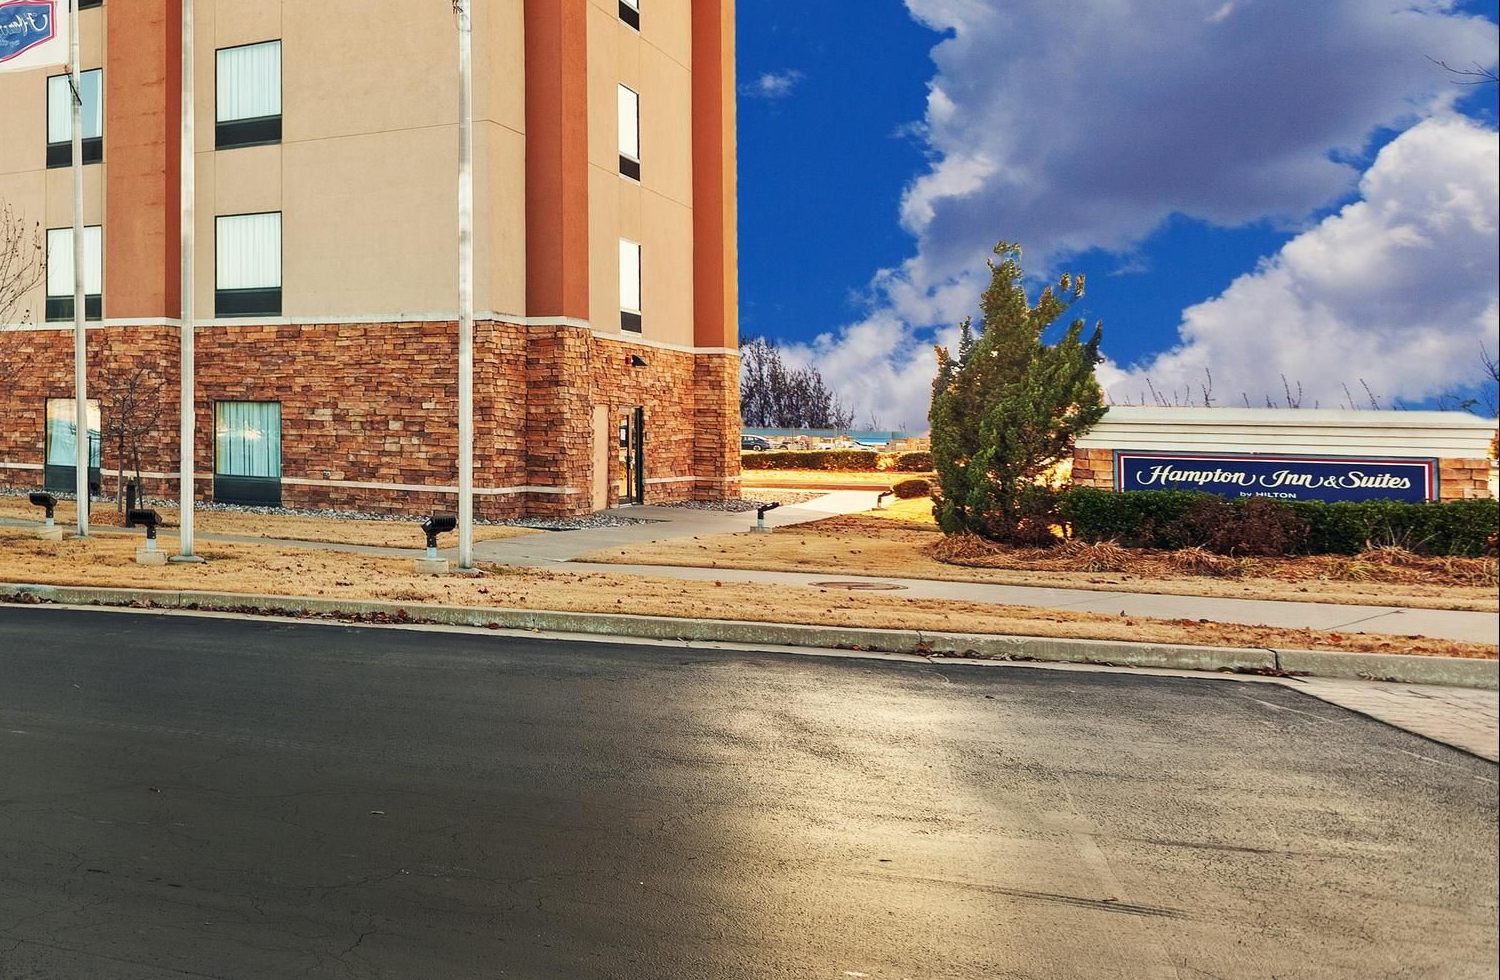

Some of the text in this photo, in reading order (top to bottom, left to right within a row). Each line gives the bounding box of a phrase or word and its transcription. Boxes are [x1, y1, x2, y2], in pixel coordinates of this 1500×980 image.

[1136, 465, 1412, 489] Hampton Inn & Suites
[1255, 491, 1297, 499] HILTON
